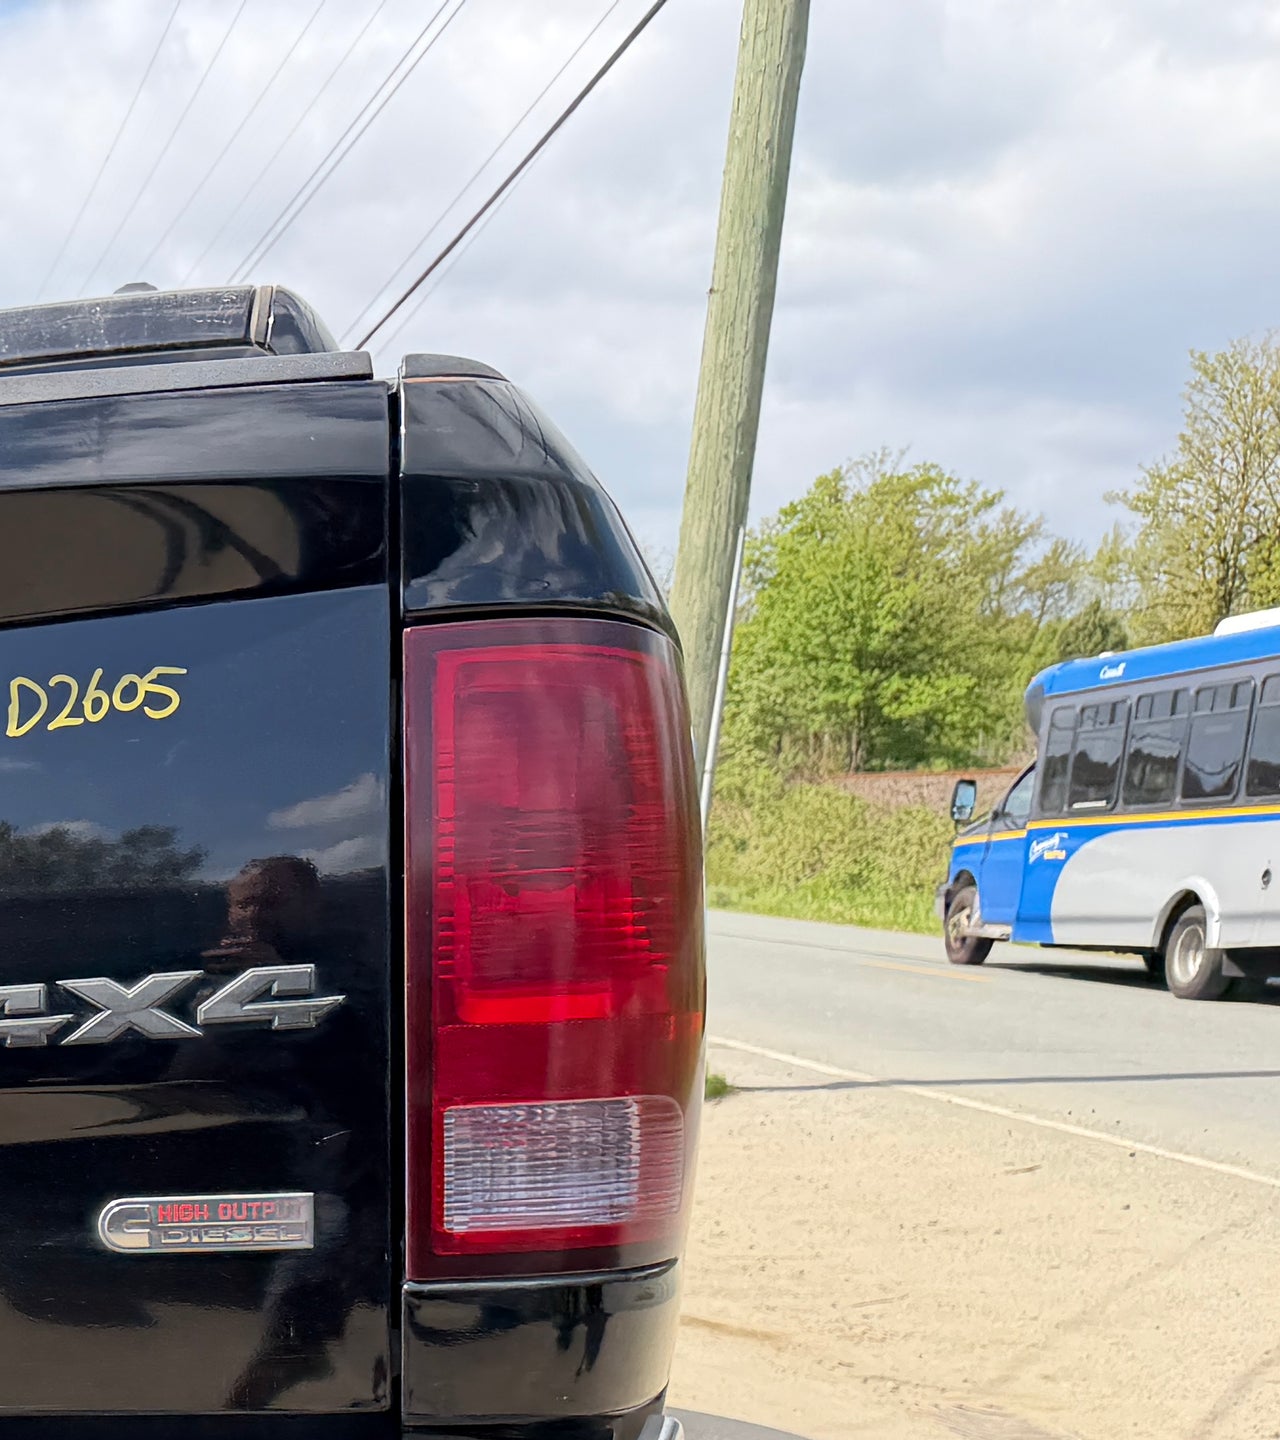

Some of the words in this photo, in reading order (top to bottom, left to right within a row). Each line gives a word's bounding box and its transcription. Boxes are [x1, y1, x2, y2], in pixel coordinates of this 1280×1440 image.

[4, 666, 188, 738] D2605
[157, 1203, 210, 1223] HIGH
[218, 1201, 302, 1220] OUTPUT
[160, 1225, 305, 1244] DIESEL
